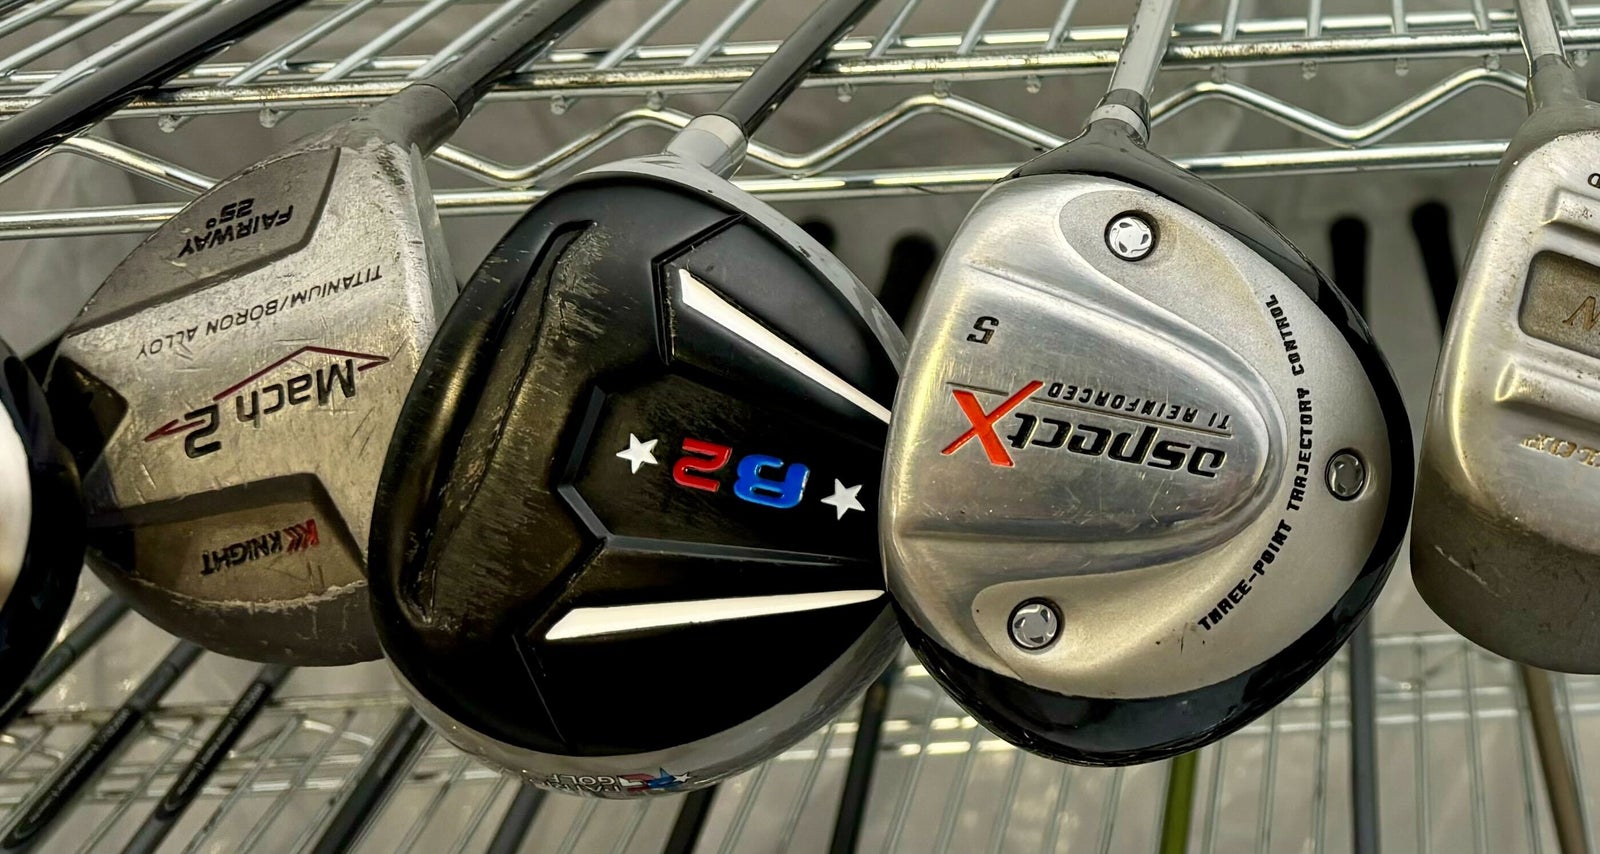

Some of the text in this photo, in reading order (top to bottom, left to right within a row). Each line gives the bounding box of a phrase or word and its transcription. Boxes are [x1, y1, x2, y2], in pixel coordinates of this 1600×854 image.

[178, 205, 293, 258] FAIRWAY
[137, 264, 382, 361] TITANIUM/BORON ALLOY
[967, 316, 1000, 345] 5
[184, 359, 355, 460] Mach 2
[1049, 381, 1230, 430] TI REINFORCED
[672, 437, 810, 509] B2
[1197, 294, 1313, 631] THREE-POINT TRAJECTORY CONTROL
[200, 530, 283, 576] KNIGHT
[551, 773, 616, 785] GOLF
